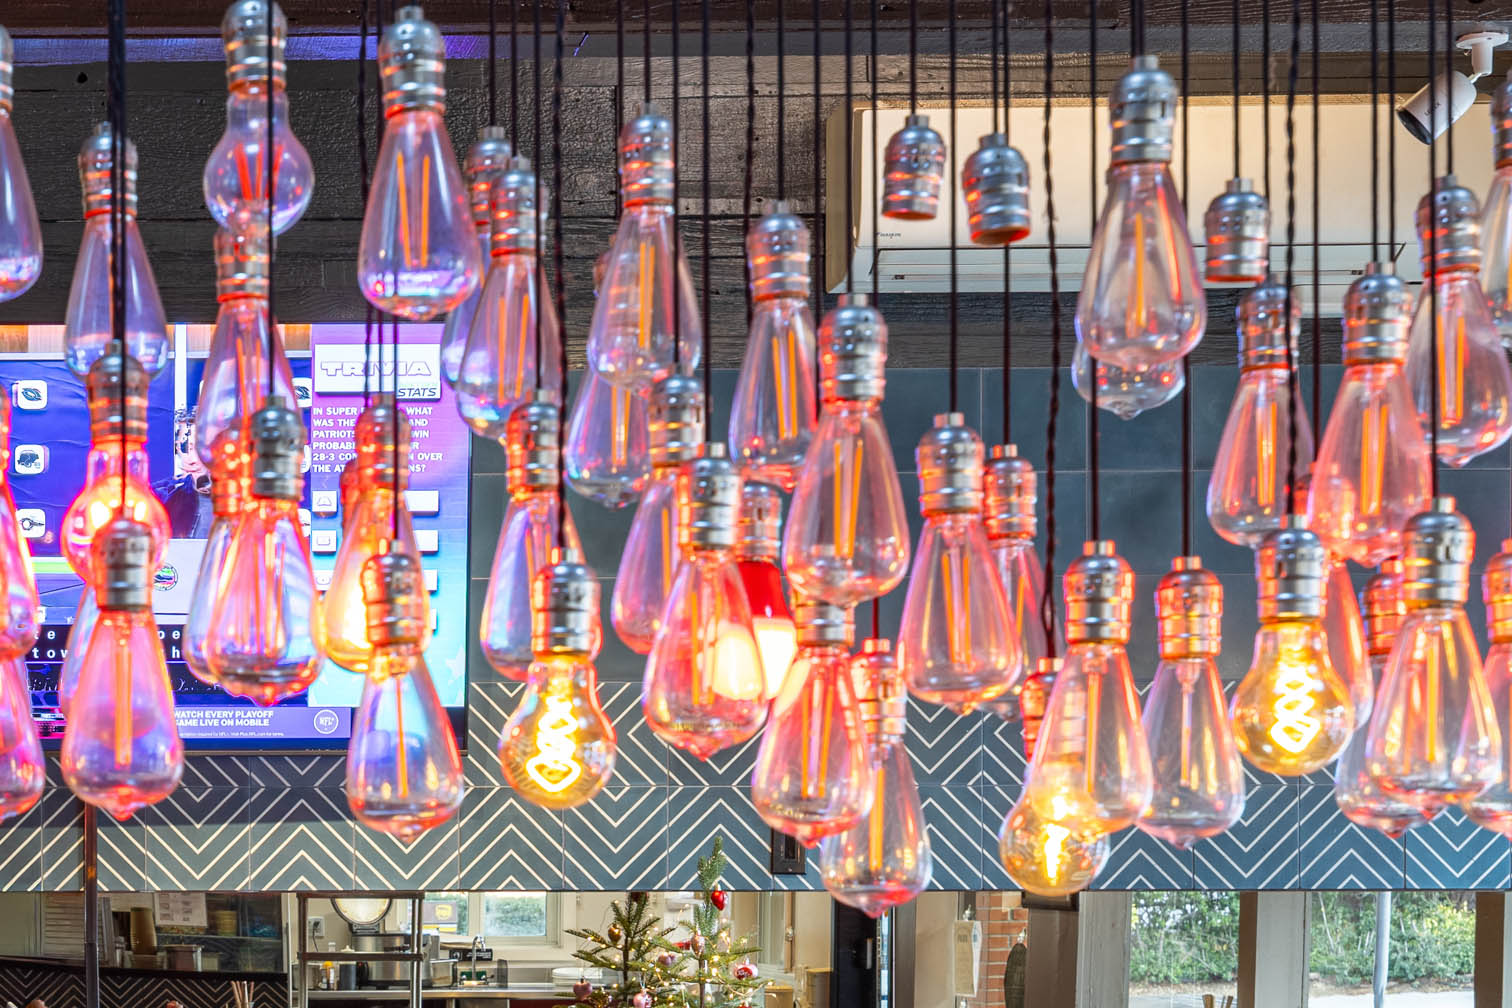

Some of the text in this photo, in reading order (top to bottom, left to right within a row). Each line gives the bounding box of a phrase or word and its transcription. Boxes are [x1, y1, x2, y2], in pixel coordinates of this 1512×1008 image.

[320, 361, 432, 377] TRIVIA
[397, 387, 437, 397] STATS
[313, 407, 323, 416] IN
[326, 407, 357, 416] SUPER
[406, 407, 432, 416] WHAT
[313, 418, 334, 427] WAS
[338, 418, 355, 427] THE
[313, 452, 335, 461] 28-3
[418, 452, 442, 461] OVER
[313, 464, 330, 473] THE
[205, 710, 234, 719] EVERY
[235, 710, 274, 719] PLAYOFF
[200, 718, 219, 727] LIVE
[221, 718, 234, 727] ON
[235, 718, 270, 727] MOBILE
